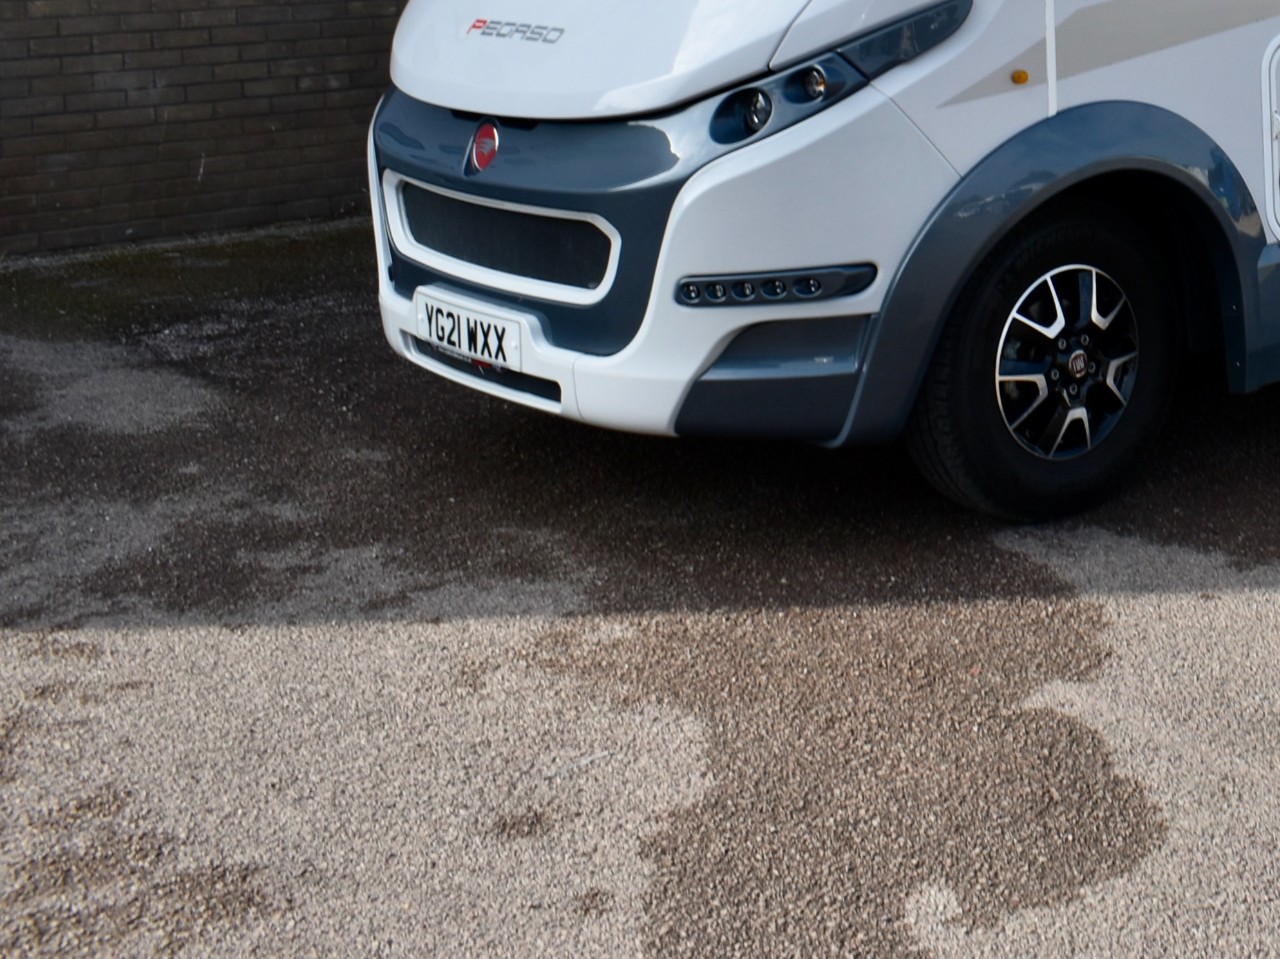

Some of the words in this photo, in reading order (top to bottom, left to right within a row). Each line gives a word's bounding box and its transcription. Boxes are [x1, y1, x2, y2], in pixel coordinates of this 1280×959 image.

[466, 18, 565, 44] PEGASO
[425, 302, 462, 349] YG21
[467, 317, 507, 362] WXX
